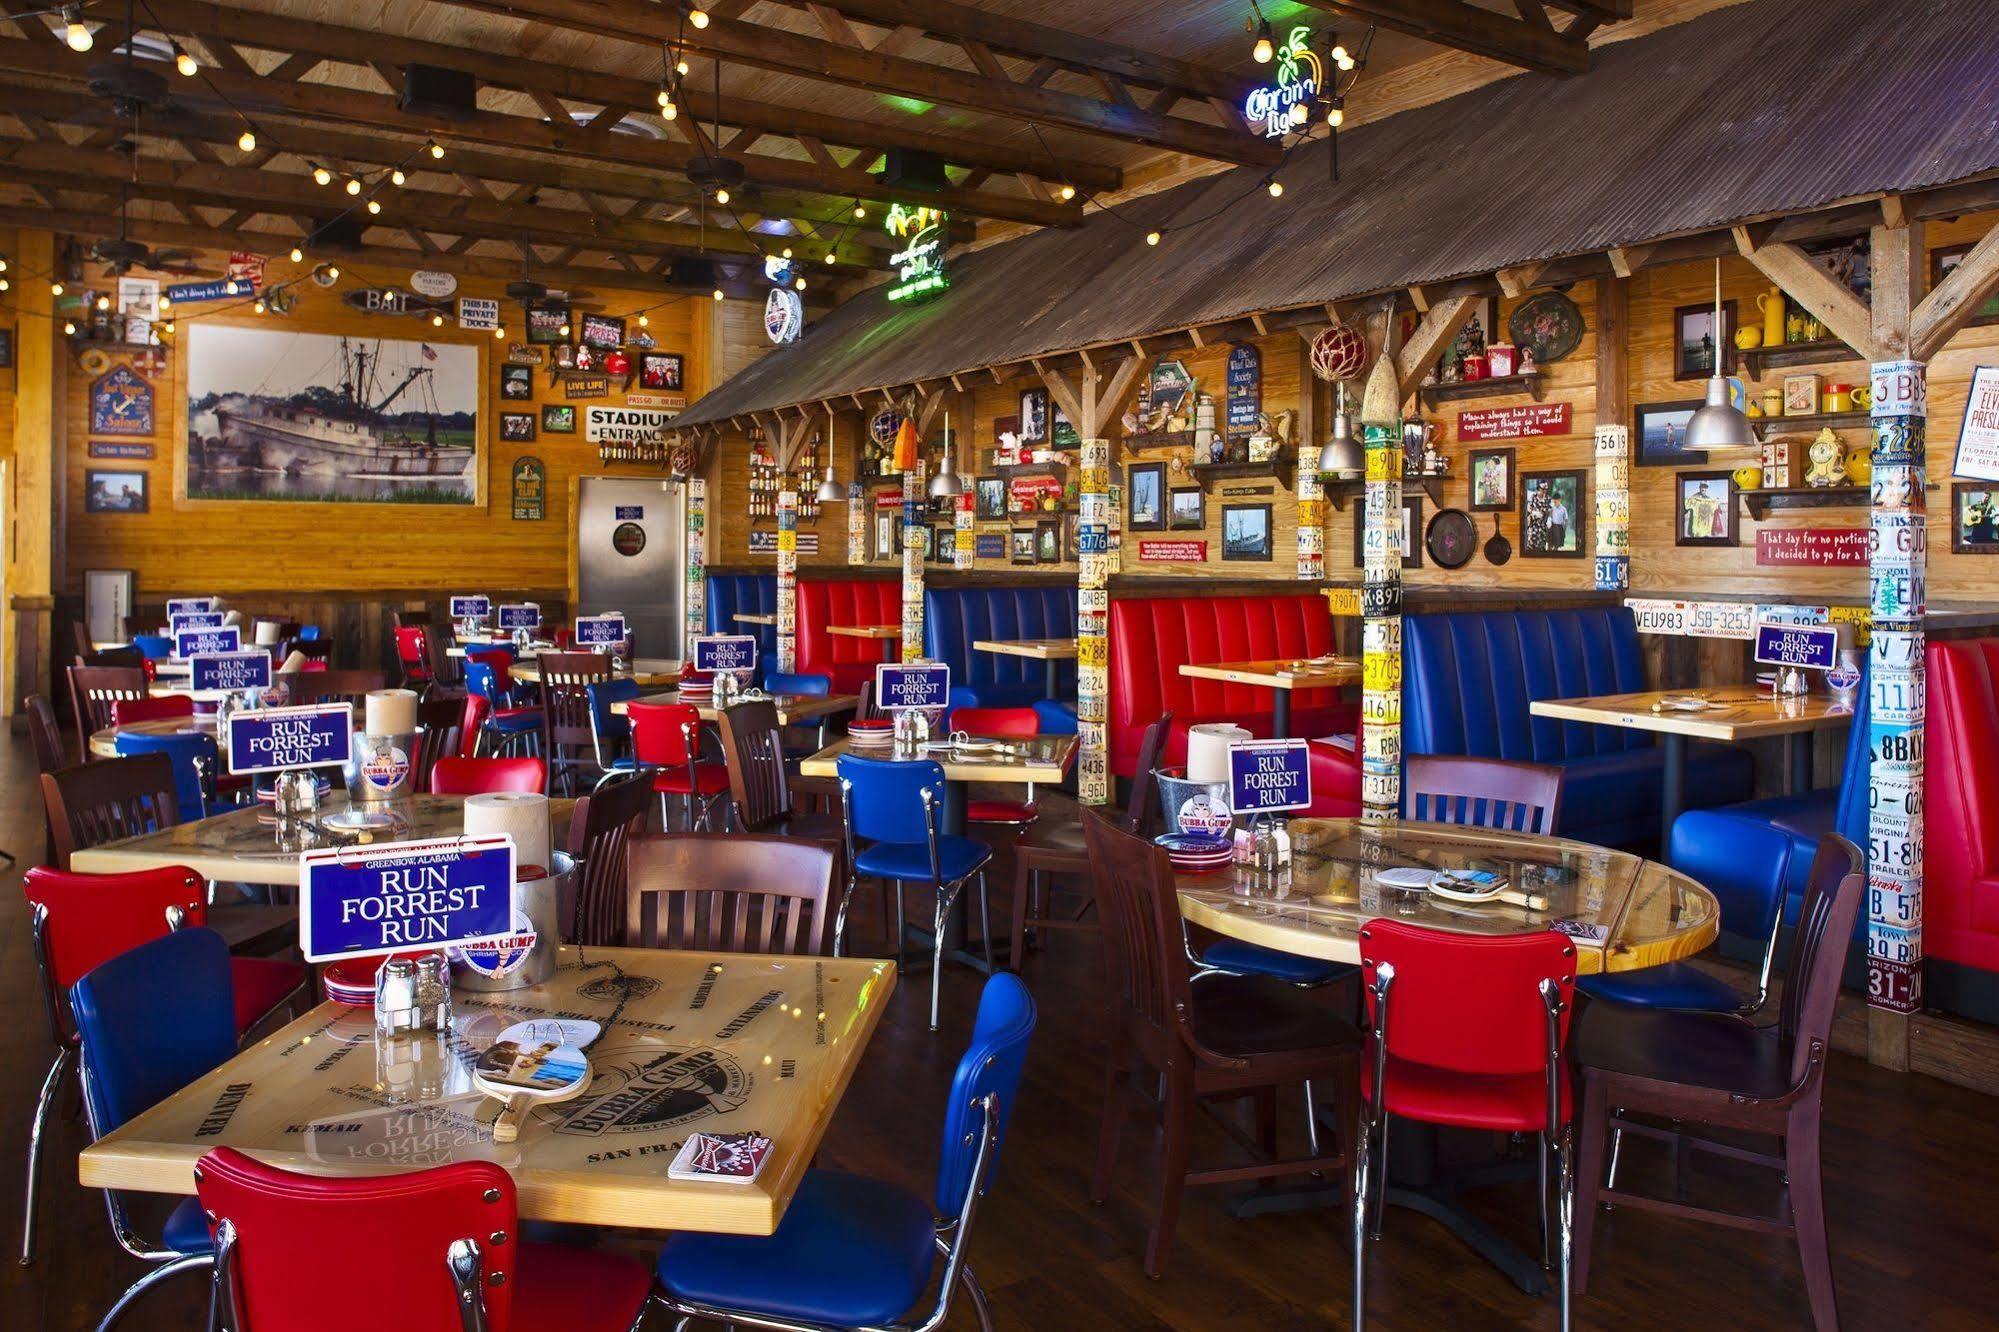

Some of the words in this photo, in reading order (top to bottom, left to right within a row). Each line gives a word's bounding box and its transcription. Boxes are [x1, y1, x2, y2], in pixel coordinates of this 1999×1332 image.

[366, 290, 408, 311] BAIT
[462, 299, 480, 308] THIS
[482, 300, 490, 309] IS
[491, 301, 498, 310] A
[463, 309, 496, 320] PRIVATE
[466, 319, 490, 328] DOCK
[567, 381, 586, 391] LIVE
[587, 380, 605, 390] LIFE
[1463, 413, 1485, 421] Mama
[1488, 410, 1510, 421] always
[1513, 408, 1526, 417] had
[1538, 408, 1551, 417] way
[1555, 404, 1563, 413] of
[1464, 421, 1497, 432] explaining
[1500, 419, 1521, 429] things
[1536, 416, 1539, 424] I
[1543, 416, 1562, 424] could
[600, 428, 664, 441] ENTRANC
[1481, 428, 1520, 438] understand
[1762, 531, 1782, 544] That
[1785, 531, 1800, 547] day
[1803, 531, 1816, 544] for
[1821, 536, 1830, 544] no
[1768, 547, 1771, 559] I
[1775, 548, 1808, 560] decided
[1811, 548, 1820, 559] to
[1824, 552, 1833, 564] go
[1837, 547, 1851, 559] for
[1636, 611, 1683, 629] VEU983
[1690, 609, 1751, 631] JSB-3253
[198, 633, 220, 641] RUN
[583, 628, 617, 637] FORREST
[592, 634, 610, 642] RUN
[1783, 632, 1810, 644] RUN
[187, 640, 230, 651] FORREST
[716, 643, 737, 652] RUN
[1768, 640, 1824, 656] FORREST
[705, 650, 746, 661] FORREST
[1781, 651, 1808, 664] RUN
[219, 660, 245, 671] RUN
[716, 659, 736, 669] RUN
[204, 668, 259, 680] FORREST
[903, 673, 928, 685] RUN
[219, 679, 246, 689] RUN
[891, 683, 940, 695] FORREST
[903, 694, 927, 705] RUN
[271, 720, 312, 738] RUN
[249, 732, 334, 754] FORREST
[272, 748, 312, 766] RUN
[1258, 756, 1285, 772] RUN
[363, 767, 388, 776] BUBBA
[1244, 770, 1299, 790] FORREST
[1259, 788, 1287, 806] RUN
[1180, 817, 1206, 827] BUBBA
[1208, 817, 1232, 828] GUMP
[1872, 816, 1908, 828] BLOUNT
[366, 857, 418, 870] GREENBOW,
[417, 853, 461, 865] ALABAMA
[1870, 863, 1911, 877] TRAILER
[380, 865, 449, 896] RUN
[341, 884, 486, 924] FORREST
[380, 914, 449, 946] RUN
[498, 935, 536, 949] GUMP
[715, 989, 784, 1040] GATLINBURG
[563, 1086, 658, 1134] BUBBA
[641, 1050, 718, 1086] GUMP
[194, 1082, 253, 1138] DENVER
[587, 1147, 632, 1164] SAN
